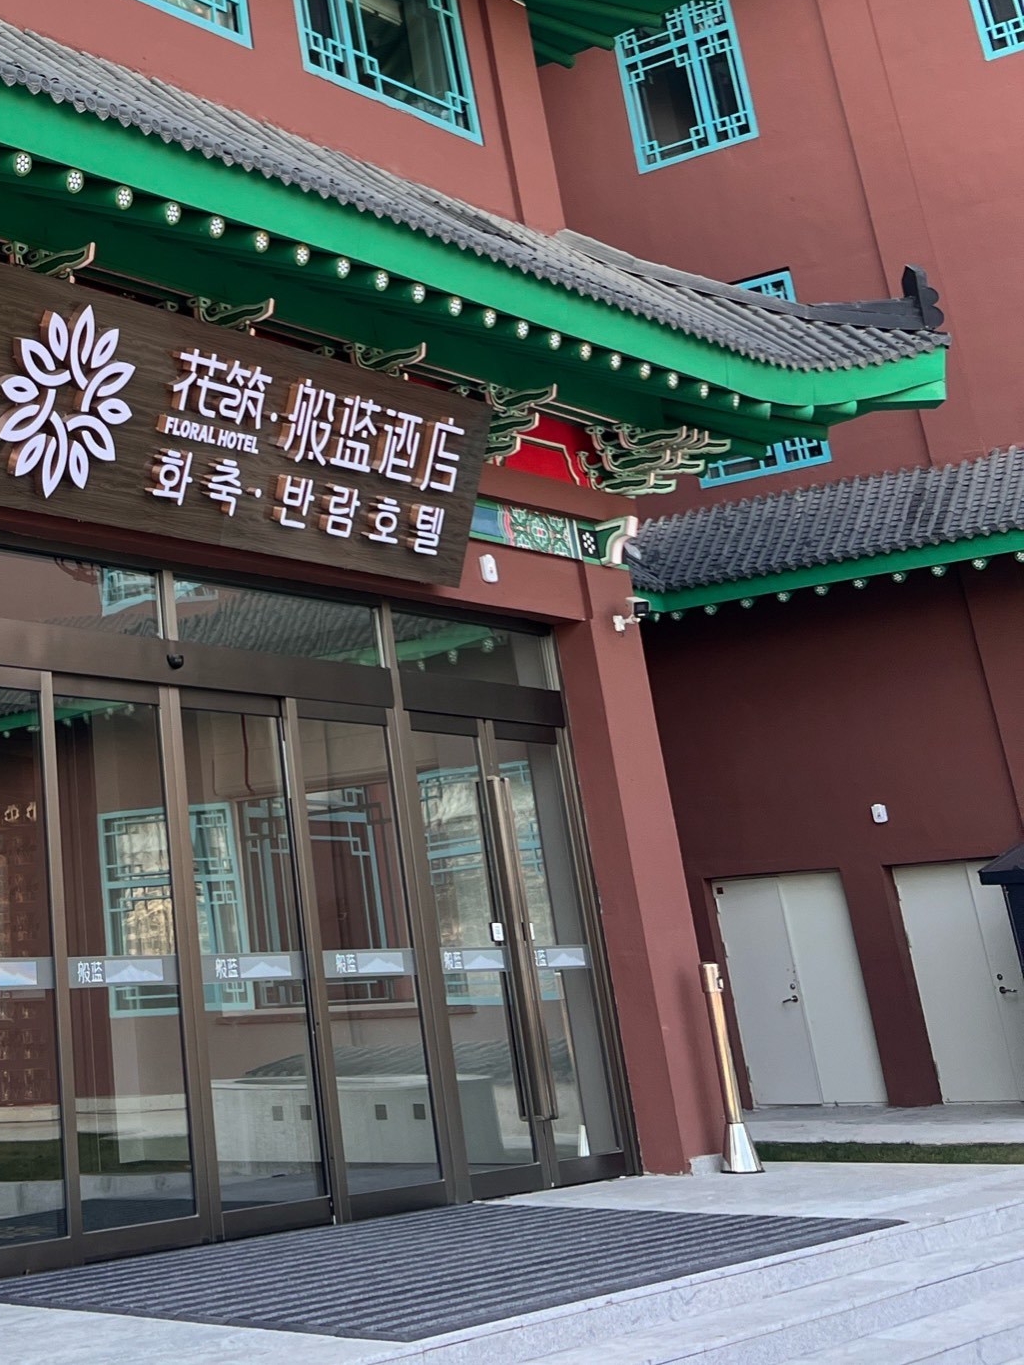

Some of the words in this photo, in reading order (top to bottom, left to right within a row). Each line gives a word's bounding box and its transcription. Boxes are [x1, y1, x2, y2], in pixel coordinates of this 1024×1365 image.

[164, 416, 216, 445] FLORAL
[217, 428, 259, 454] HOTEL
[77, 961, 104, 984] 般蓝
